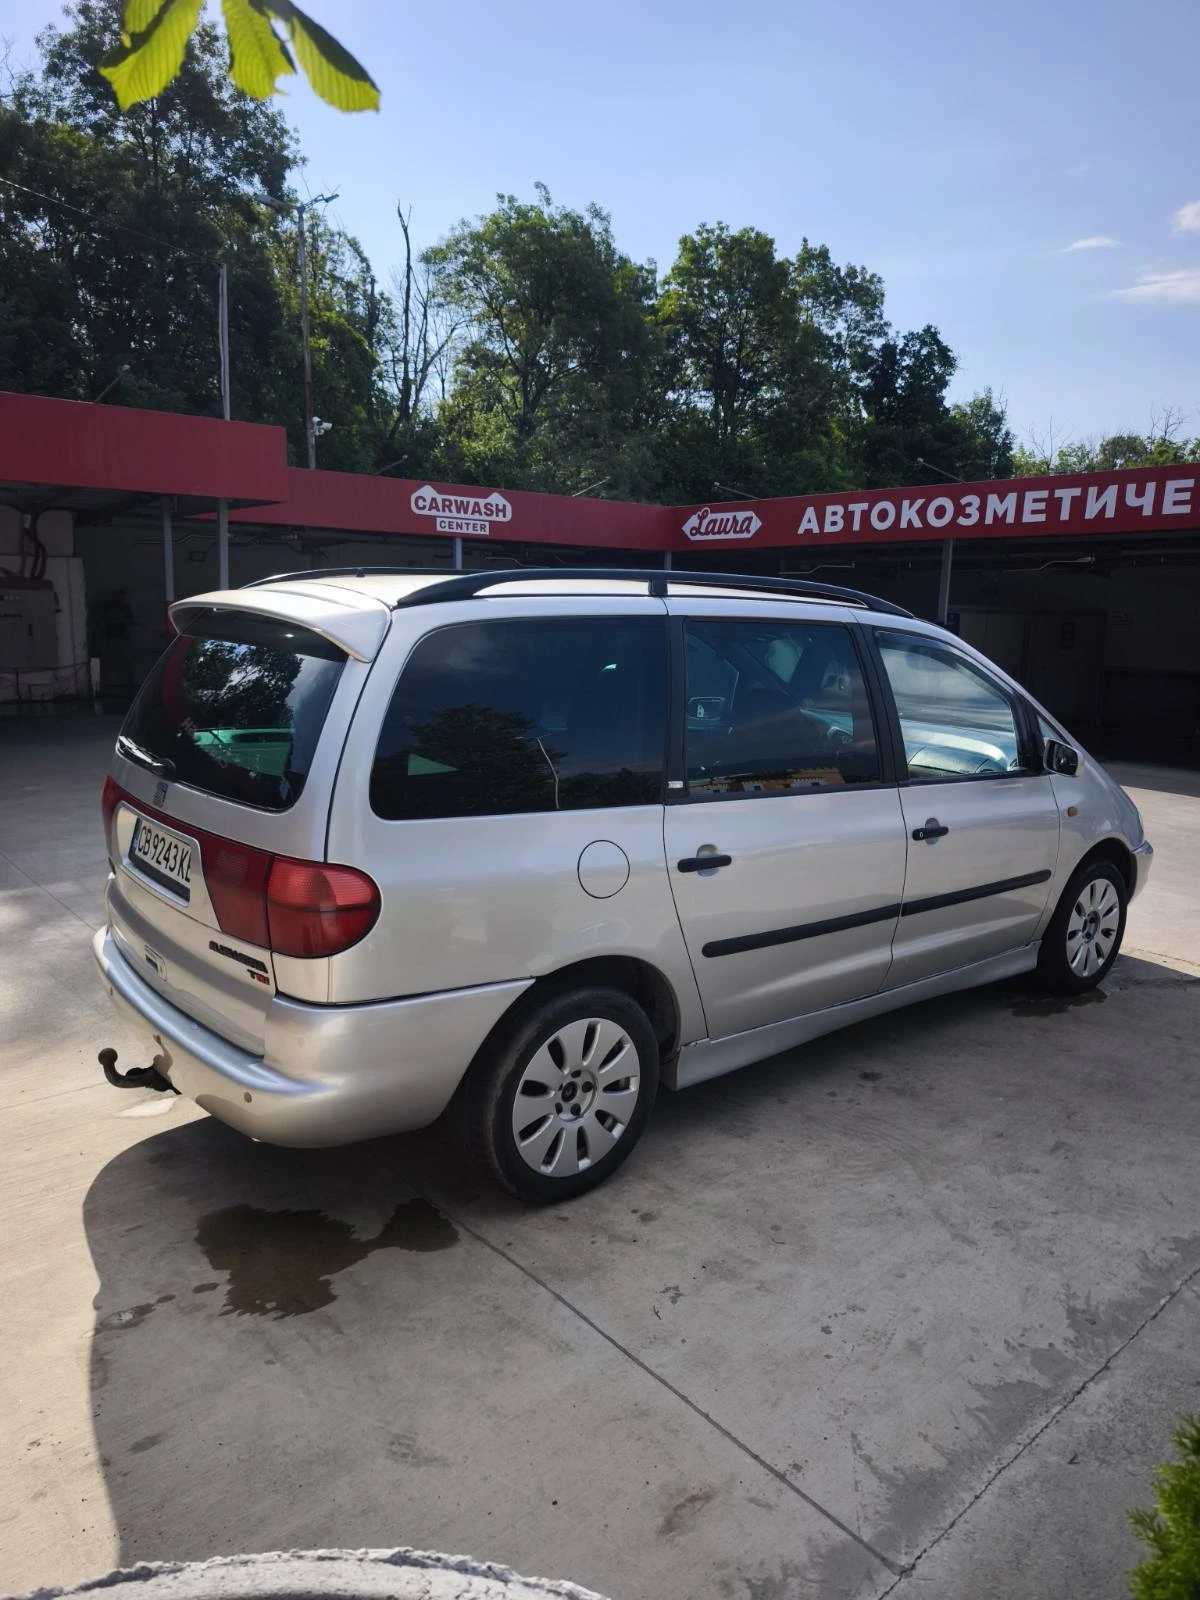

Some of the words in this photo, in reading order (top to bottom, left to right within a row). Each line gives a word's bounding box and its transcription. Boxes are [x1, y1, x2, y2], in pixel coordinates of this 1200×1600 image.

[414, 495, 507, 518] CARWASH
[797, 478, 1195, 535] АВТОКОЗМЕТИЧЕ
[439, 520, 487, 533] CENTER
[689, 508, 754, 537] Laura
[151, 833, 179, 873] 9243
